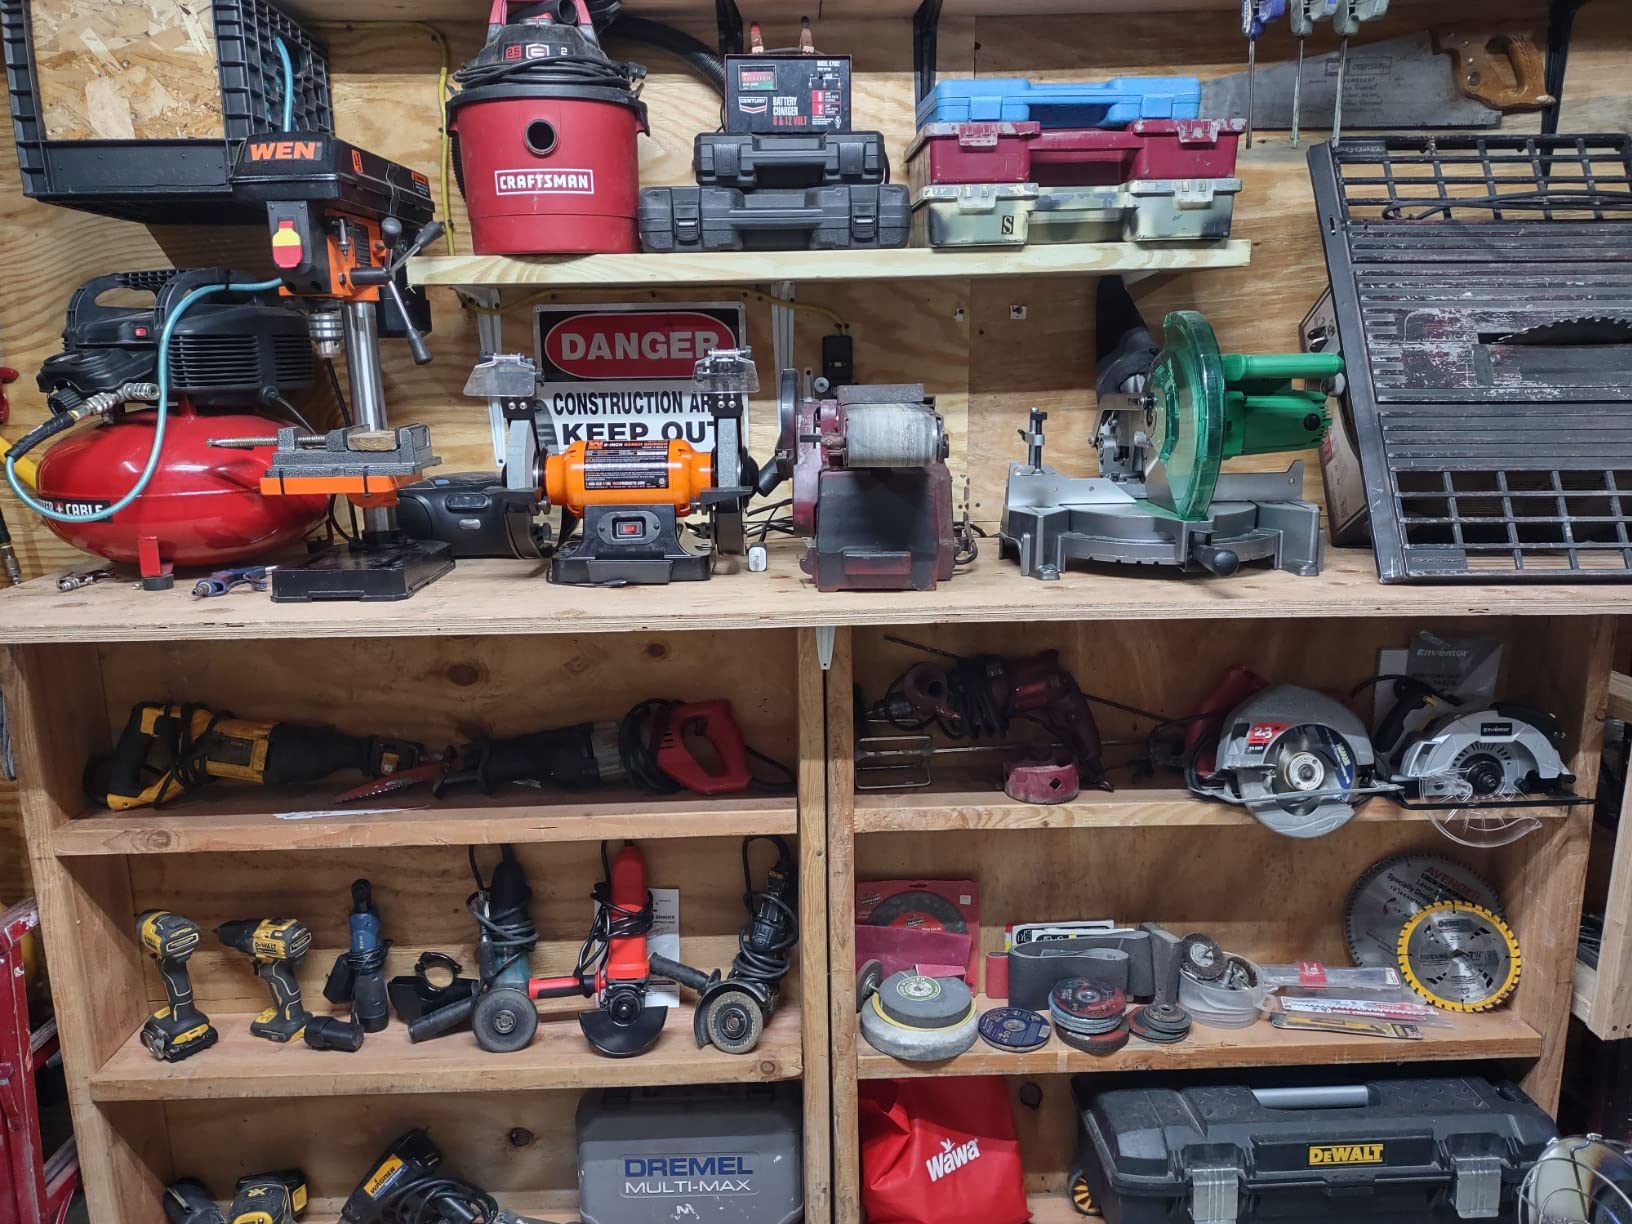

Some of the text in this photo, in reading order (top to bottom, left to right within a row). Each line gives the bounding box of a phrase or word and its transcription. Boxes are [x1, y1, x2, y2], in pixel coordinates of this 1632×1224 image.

[507, 47, 520, 58] 2.5
[773, 96, 798, 106] BATTERY
[773, 106, 798, 116] CHARGER
[785, 116, 793, 126] 12
[794, 116, 808, 126] VOLT
[250, 142, 316, 161] WEN
[500, 174, 588, 190] CRAFTSMAN
[1003, 216, 1013, 234] S
[560, 331, 719, 361] DANGER
[552, 391, 682, 416] CONSTRUCTION
[562, 421, 649, 445] KEEP
[926, 1140, 980, 1183] Wawa
[1309, 1144, 1384, 1166] DEWALT
[624, 1156, 754, 1177] DREMEL
[369, 1165, 396, 1195] WAGNER
[625, 1180, 752, 1194] MULTI-MAX
